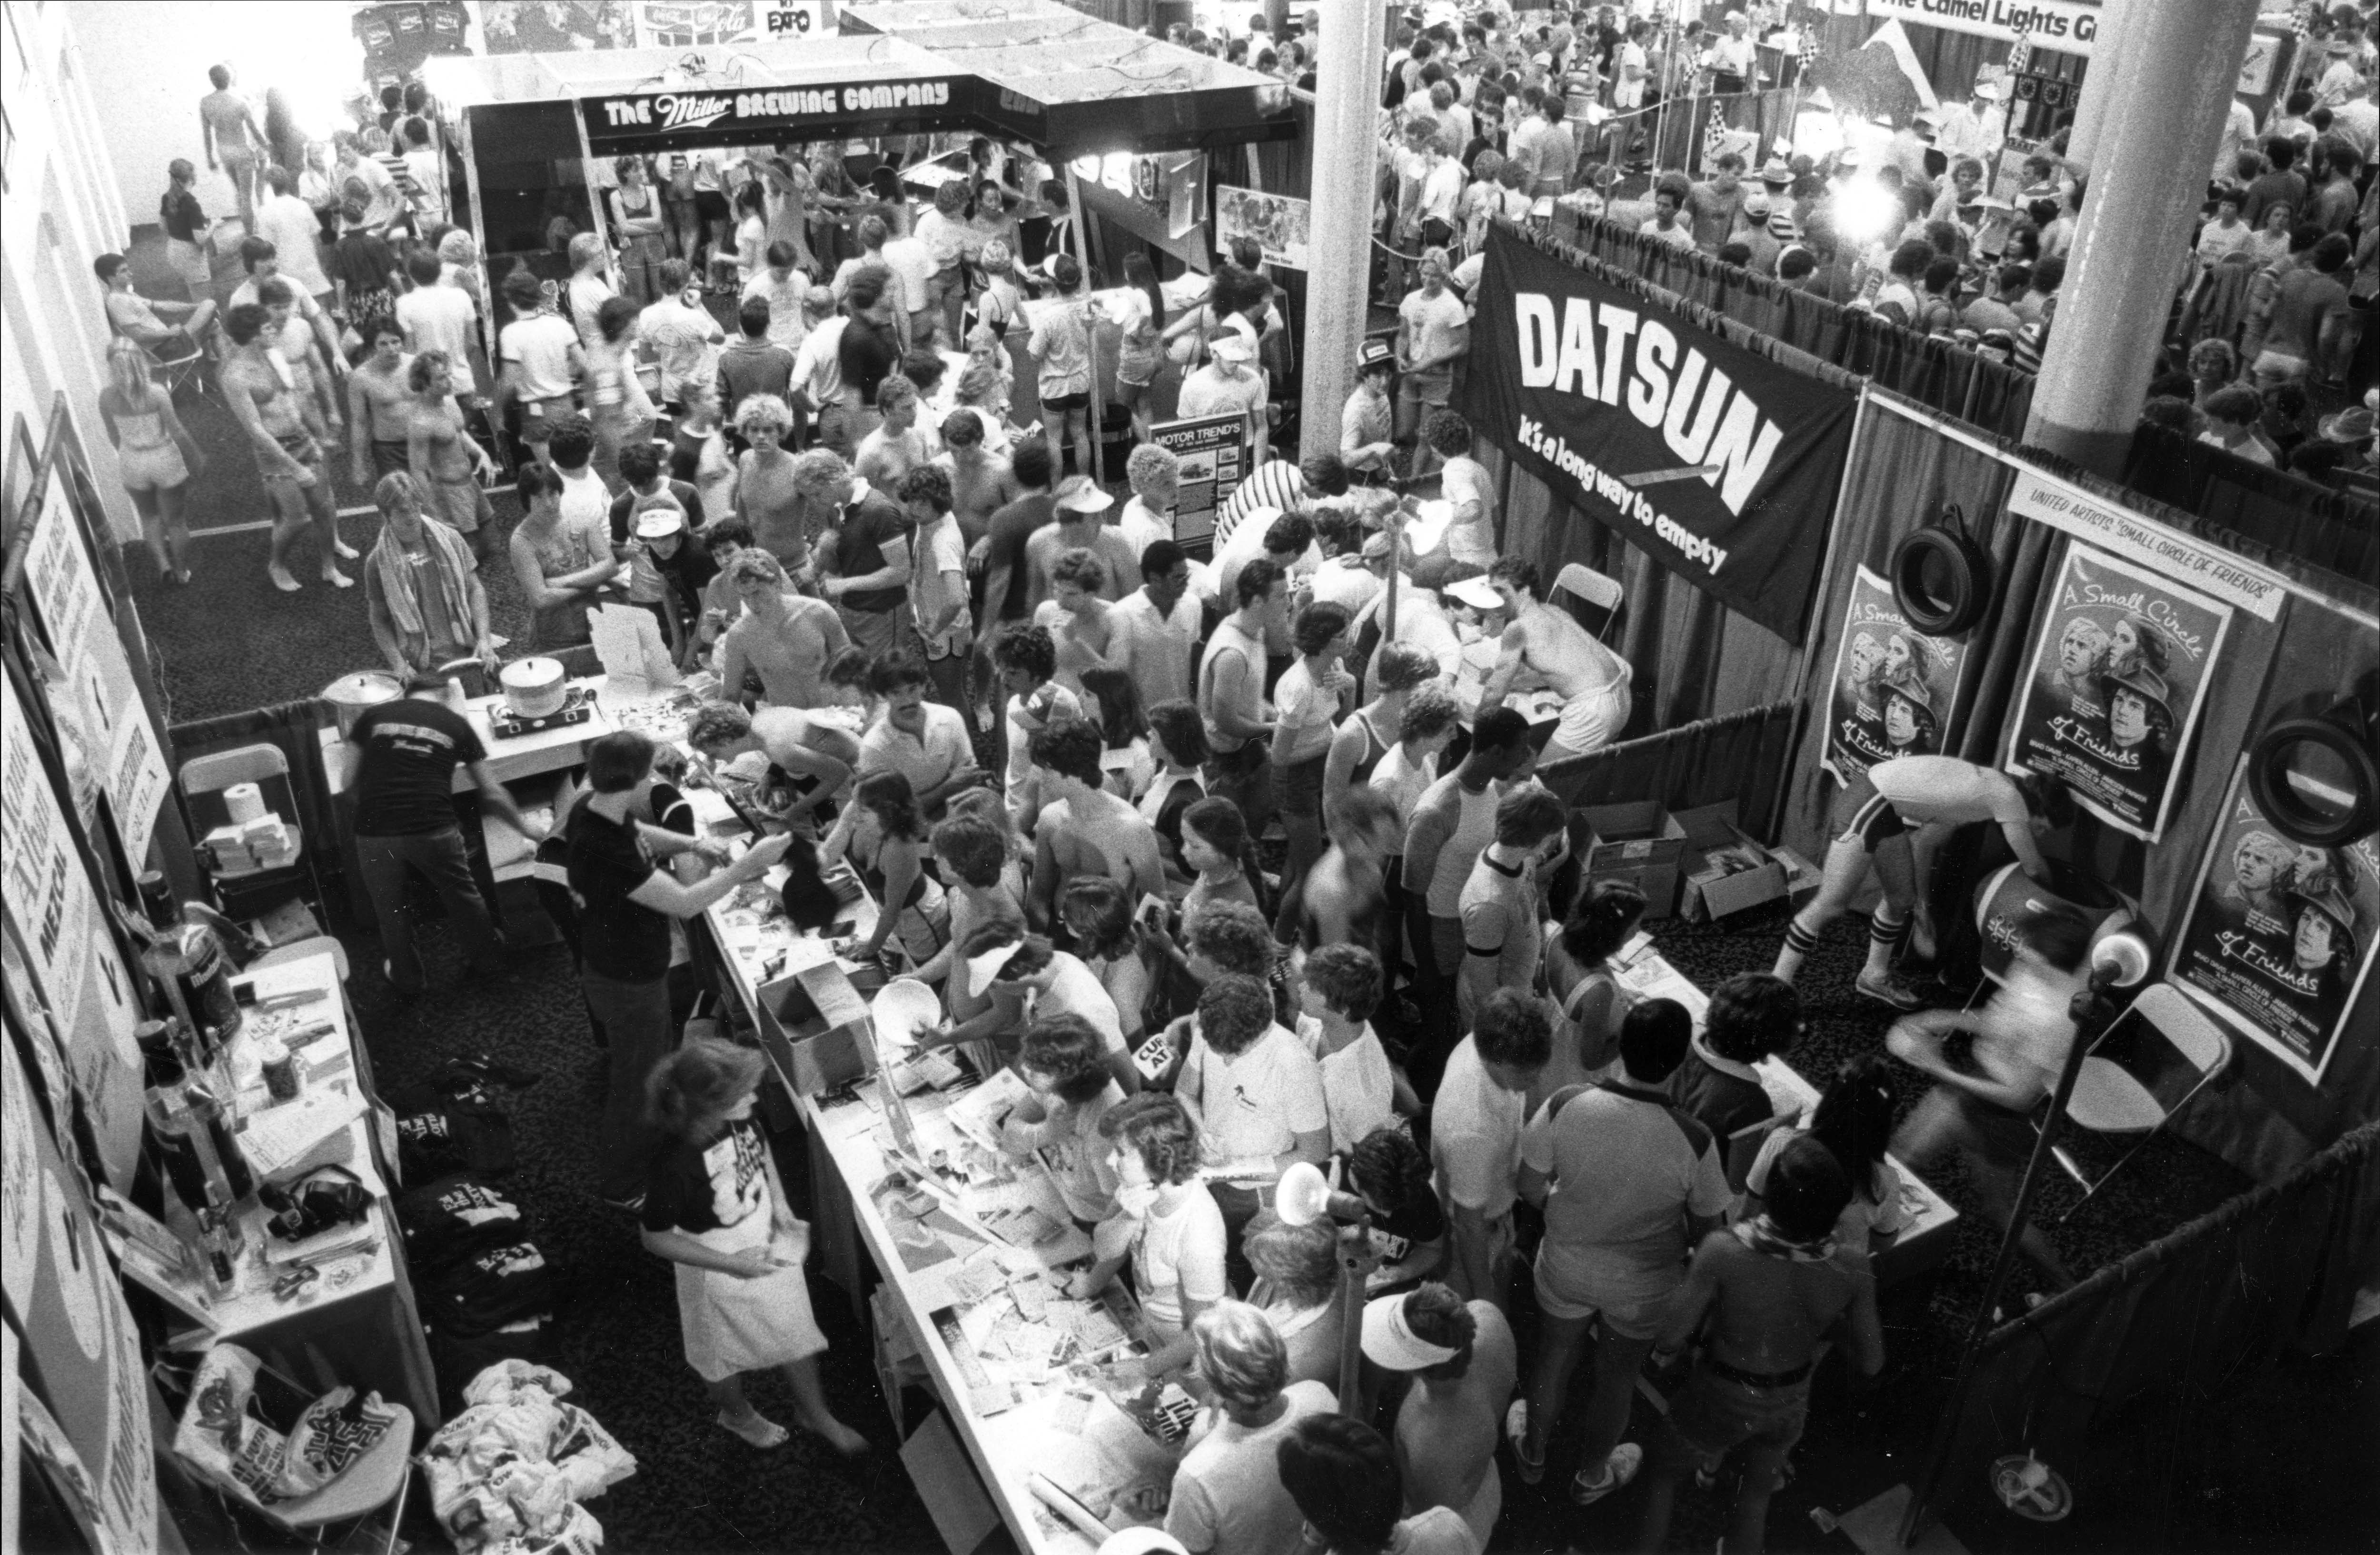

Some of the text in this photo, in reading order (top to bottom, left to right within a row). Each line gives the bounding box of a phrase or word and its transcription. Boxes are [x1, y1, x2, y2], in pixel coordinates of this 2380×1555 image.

[767, 10, 810, 33] EXPO
[1922, 0, 1989, 22] Camel
[1993, 4, 2069, 37] Lights
[655, 94, 731, 126] Miller
[736, 87, 837, 118] BREWING
[845, 82, 949, 111] COMPANY
[1516, 293, 1784, 518] DATSUN
[1155, 423, 1241, 448] MOTOR TREND'S
[1542, 436, 1556, 459] a
[1556, 436, 1594, 492] long
[1596, 470, 1634, 515] way
[1633, 491, 1655, 526] to
[1656, 513, 1727, 576] empty
[2030, 488, 2070, 511] UNITED
[2069, 504, 2113, 532] ARTISTS
[2156, 540, 2193, 565] CIRCLE
[2192, 554, 2210, 571] OF
[2211, 563, 2275, 599] FRIENDS"
[1853, 602, 1864, 621] A
[2063, 584, 2204, 659] A Small Circle
[1855, 728, 1912, 758] Friends
[2053, 715, 2141, 766] of Friends
[2236, 797, 2253, 818] A
[39, 842, 67, 970] MEZCAL
[2221, 930, 2320, 992] of Friends
